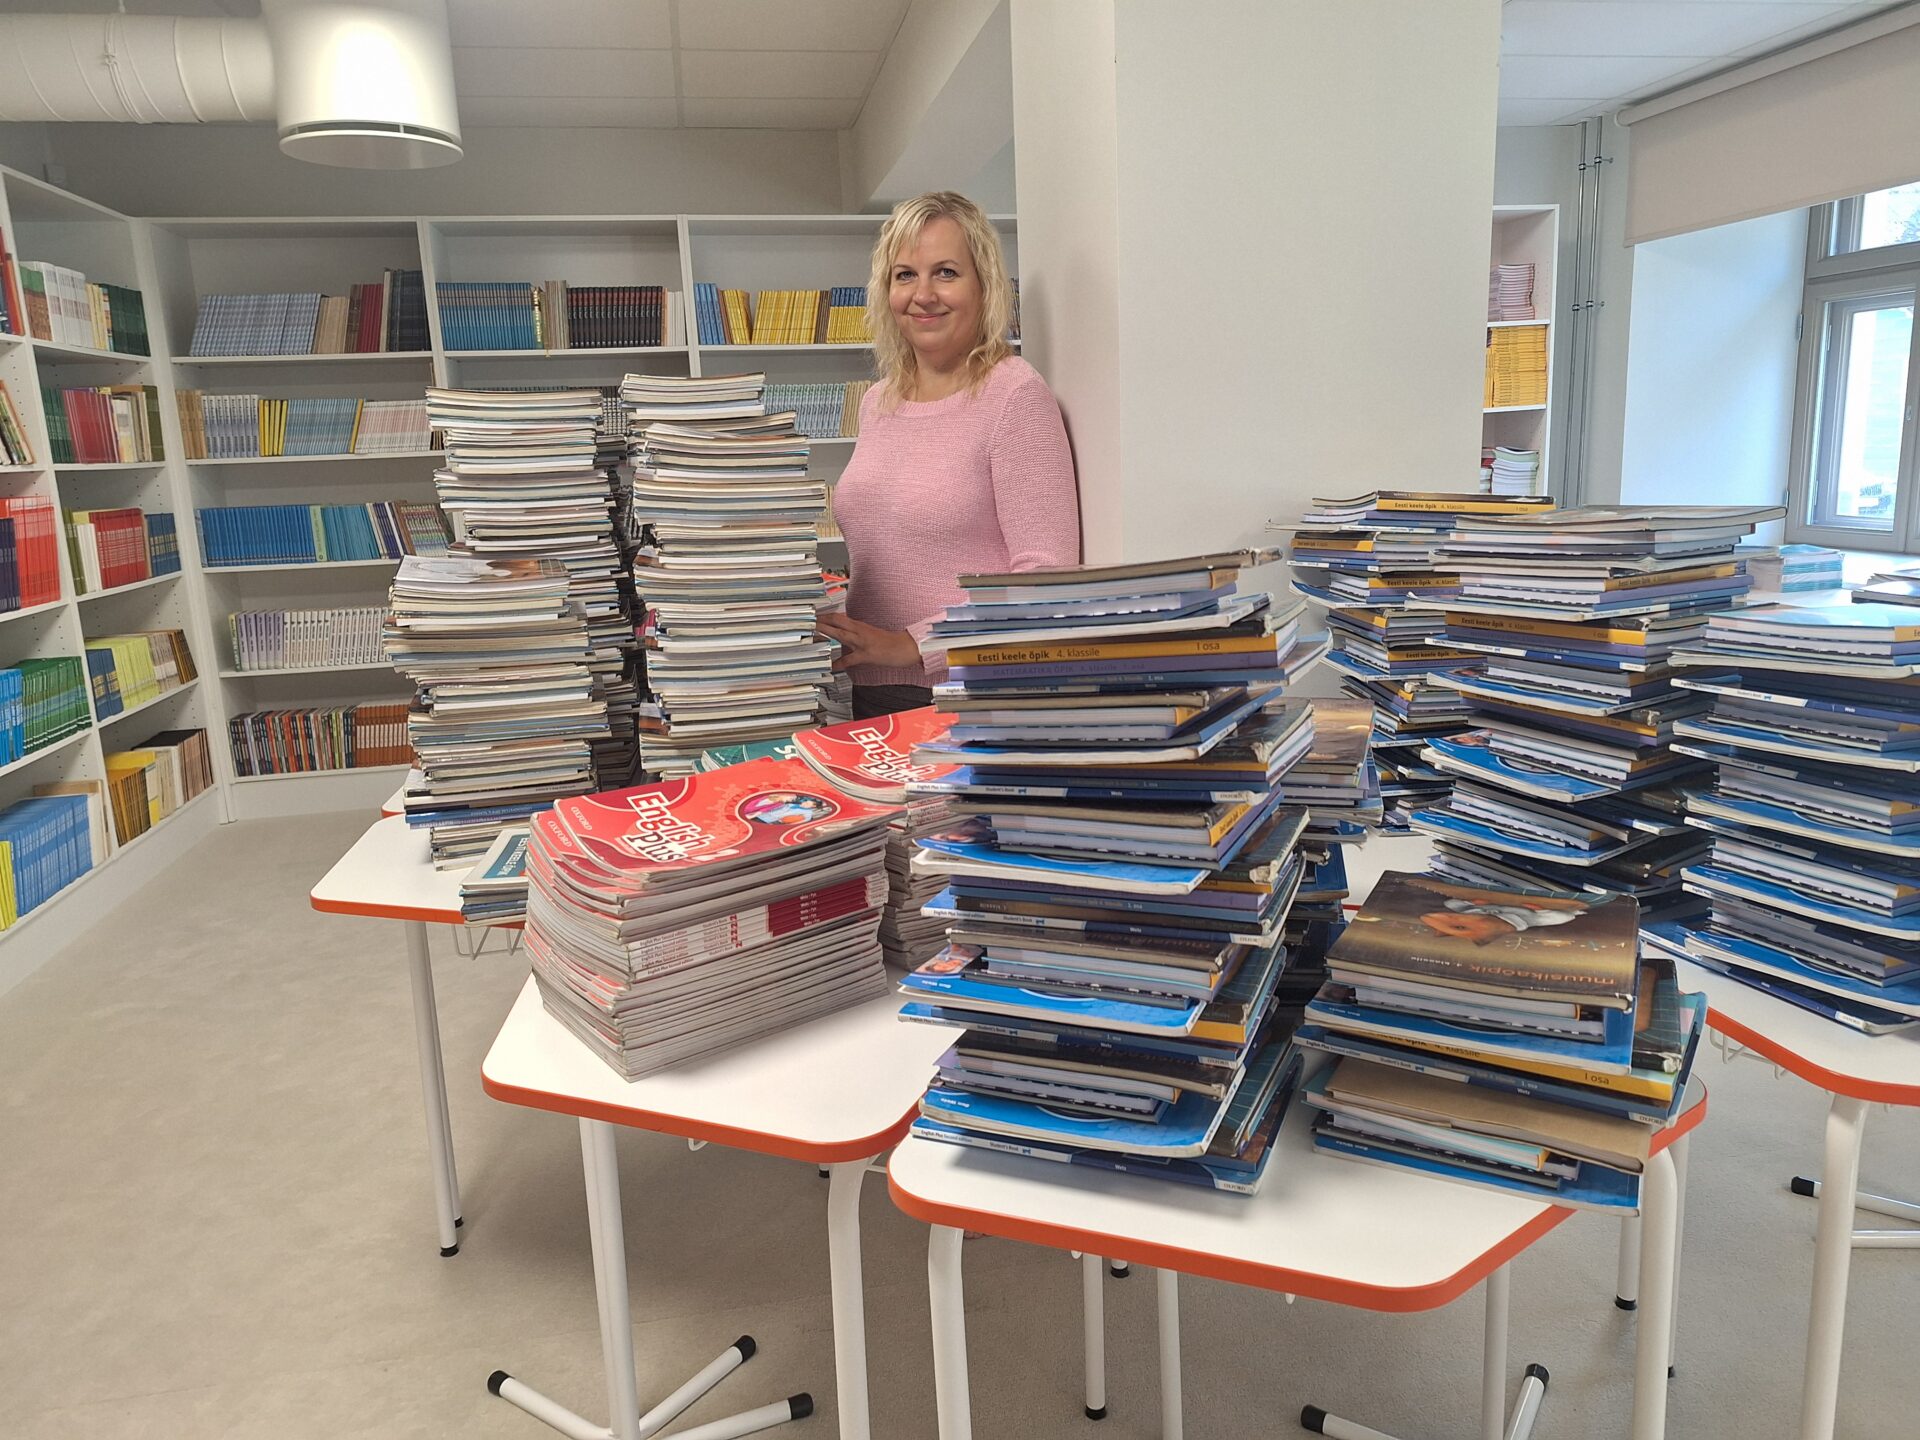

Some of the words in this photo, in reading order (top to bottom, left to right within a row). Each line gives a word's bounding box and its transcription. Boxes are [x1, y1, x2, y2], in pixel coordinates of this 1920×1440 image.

[1202, 643, 1220, 651] osa
[977, 653, 999, 663] Eesti
[1001, 651, 1027, 661] keele
[1029, 649, 1050, 663] õpik
[1056, 649, 1066, 658] 4.
[1067, 648, 1100, 658] klassile
[571, 806, 592, 831] OXFORD
[627, 792, 715, 849] English
[547, 821, 573, 848] OXFORD
[623, 832, 688, 862] Plus
[1306, 1040, 1320, 1049] English
[1590, 1074, 1610, 1085] osa
[920, 1129, 935, 1137] English
[989, 1142, 1008, 1150] Student's
[1008, 1144, 1019, 1152] Book
